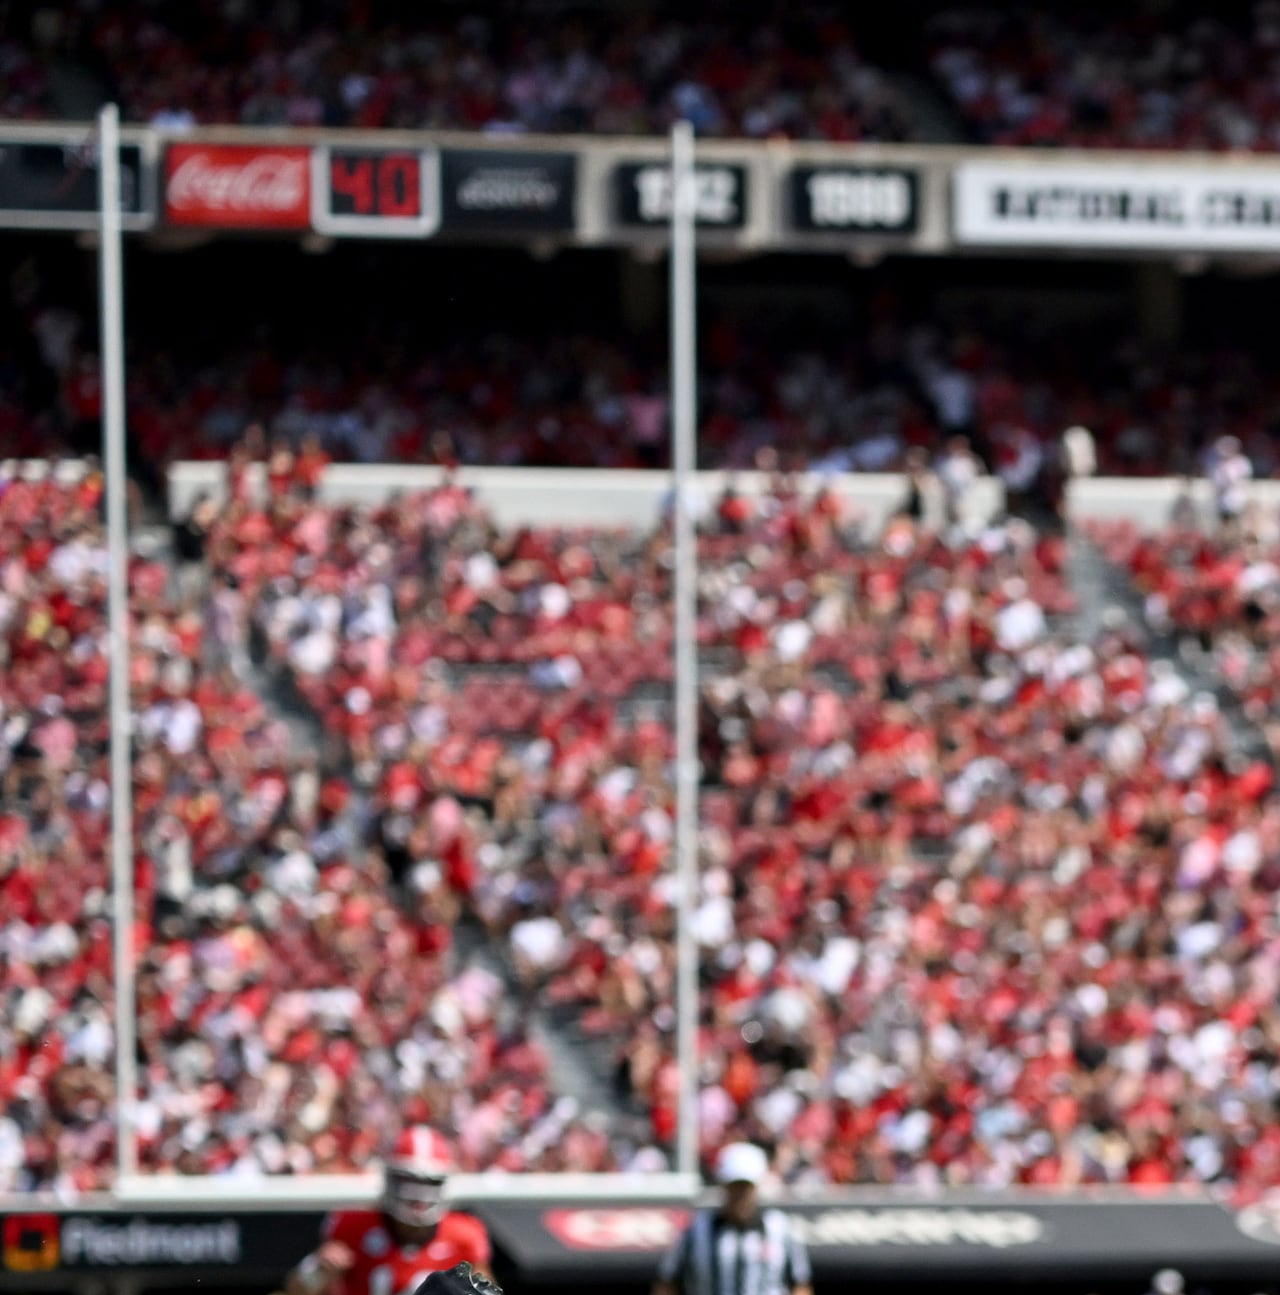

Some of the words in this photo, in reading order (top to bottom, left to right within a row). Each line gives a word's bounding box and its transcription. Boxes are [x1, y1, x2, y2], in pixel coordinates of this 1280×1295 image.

[331, 153, 421, 217] 40
[990, 183, 1185, 222] NATIONAL
[62, 1218, 241, 1265] Piedmont
